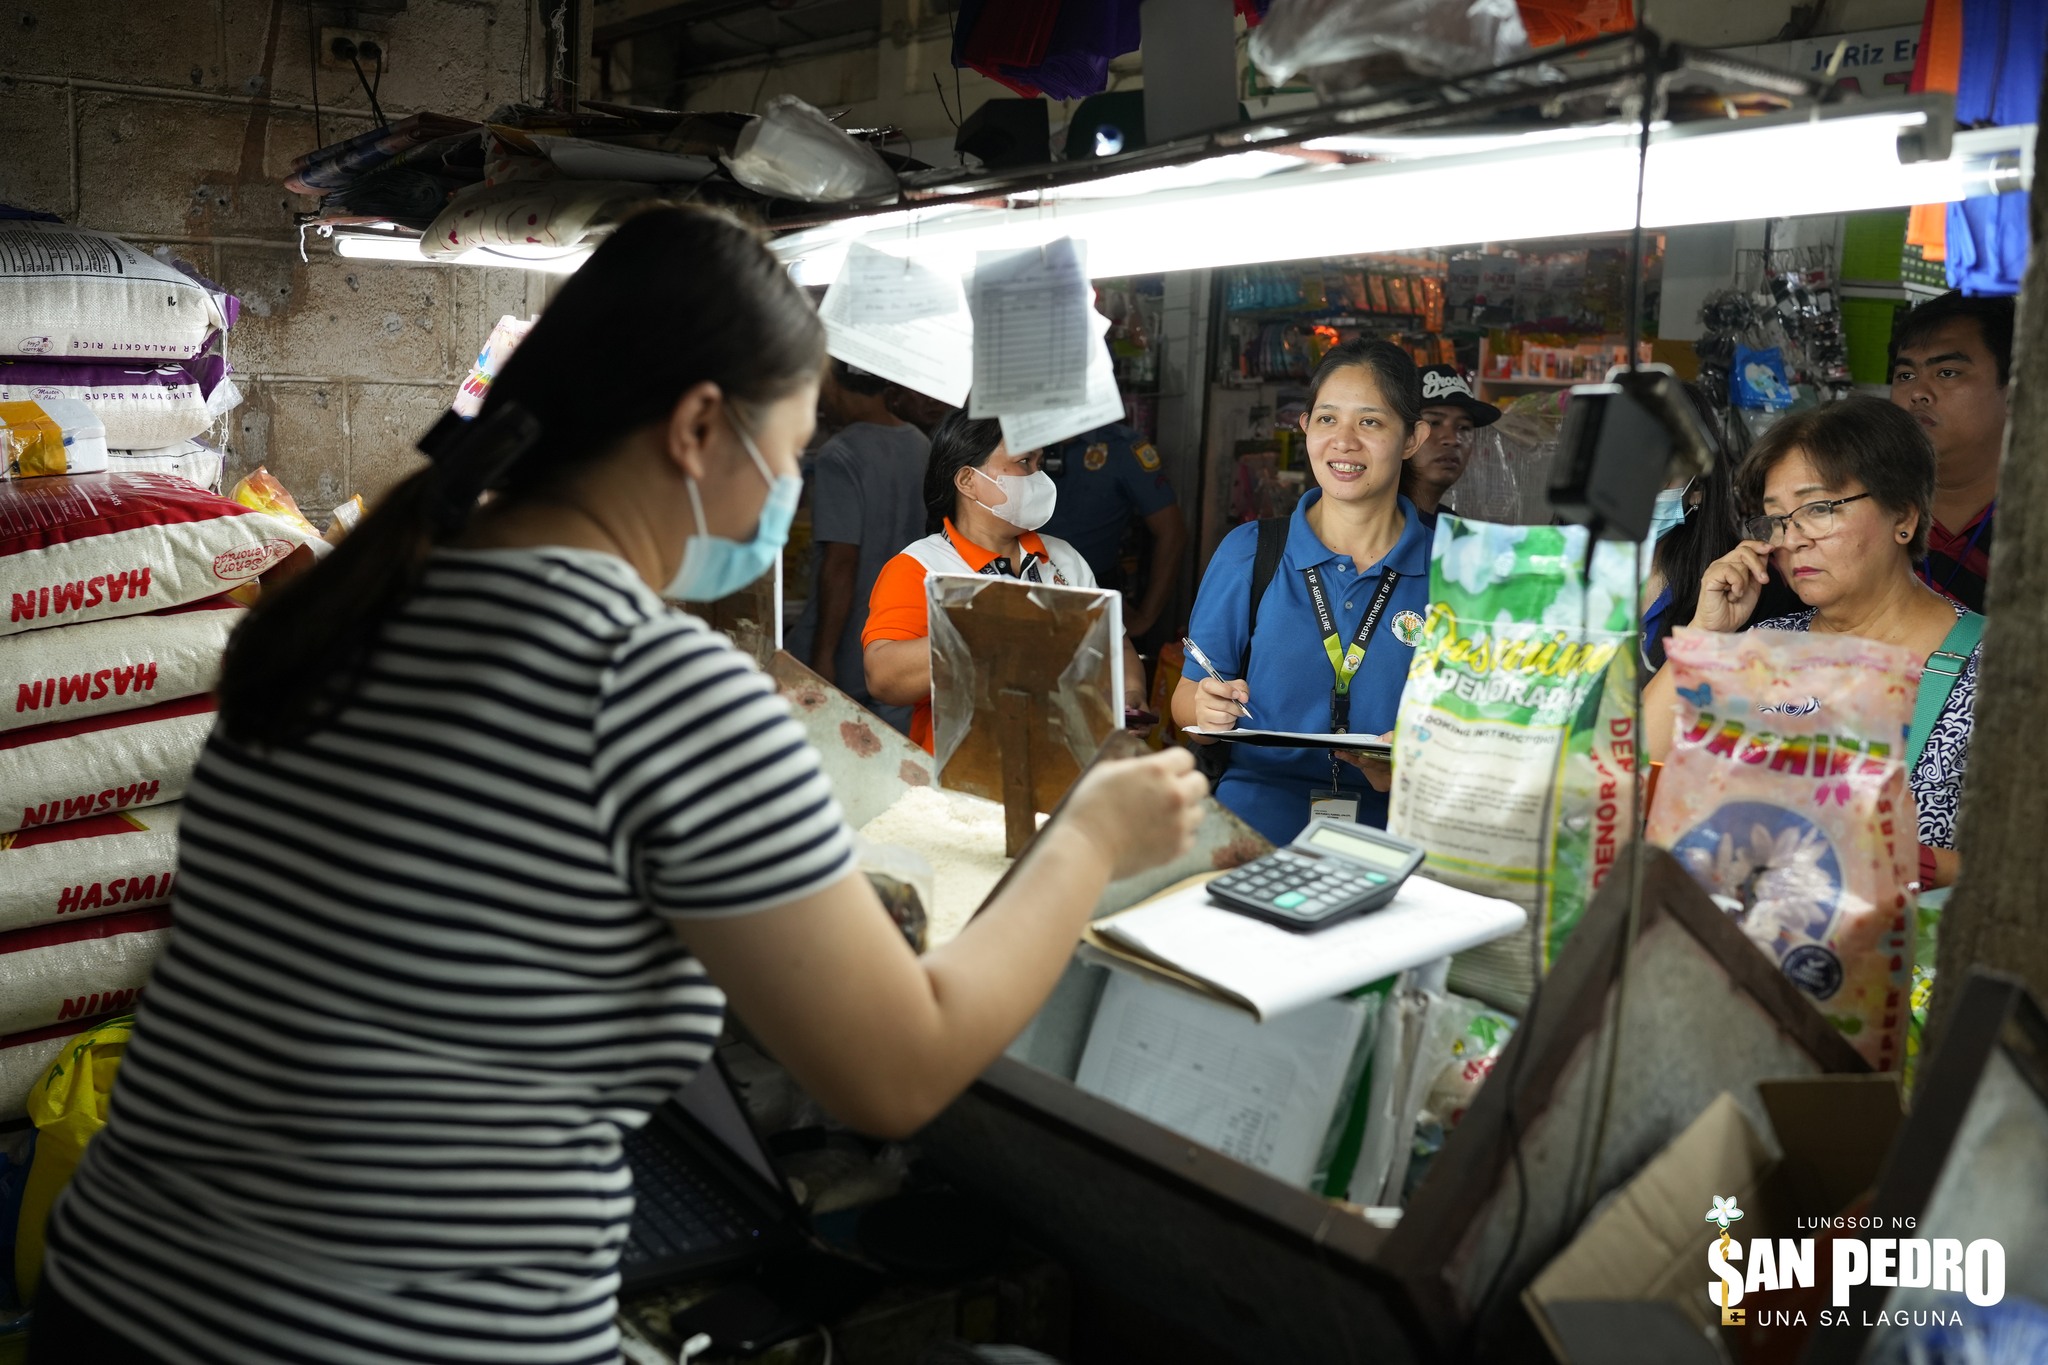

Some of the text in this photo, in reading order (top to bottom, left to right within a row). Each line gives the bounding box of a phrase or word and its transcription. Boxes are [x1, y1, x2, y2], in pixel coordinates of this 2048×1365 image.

[73, 341, 104, 350] RICE
[111, 342, 177, 353] MALAGKIT
[85, 391, 194, 401] SUPER MALAGKIT
[220, 557, 263, 575] Señor
[1308, 574, 1318, 584] OF
[11, 566, 151, 623] HASMIN
[1311, 585, 1332, 632] AGRICULTURE
[1358, 593, 1387, 642] DEPARTMENT
[1381, 582, 1391, 594] OF
[16, 661, 158, 713] HASMIN
[1683, 711, 1891, 778] JASMINE
[20, 779, 161, 828] HASMIN
